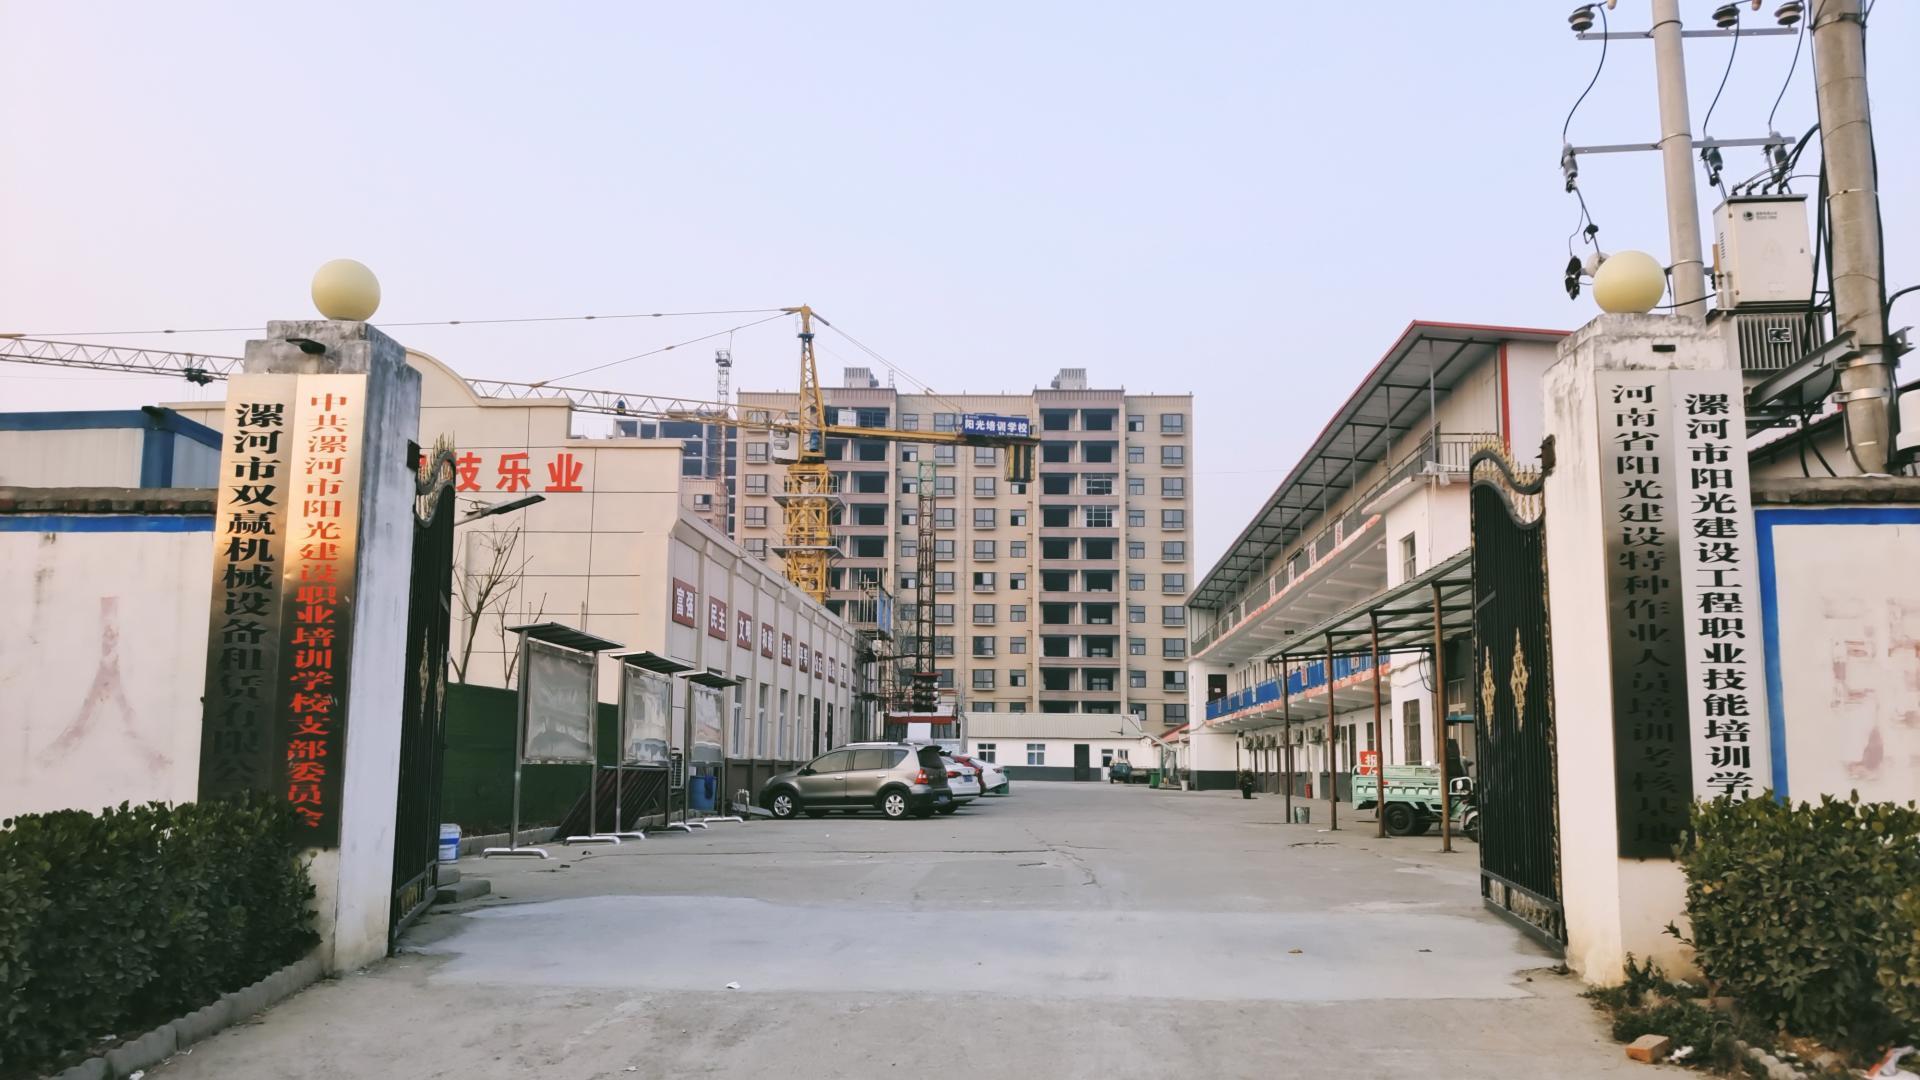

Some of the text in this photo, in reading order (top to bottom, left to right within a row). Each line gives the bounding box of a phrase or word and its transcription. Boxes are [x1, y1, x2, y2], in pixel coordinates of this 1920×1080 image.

[964, 419, 1028, 433] 阳光培训学校
[419, 451, 584, 493] 技乐业
[676, 587, 694, 618] 富强
[1684, 393, 1755, 804] 漯河市阳光建设工程职业技能培训学
[711, 603, 726, 632] 民主
[738, 617, 751, 642] 文明
